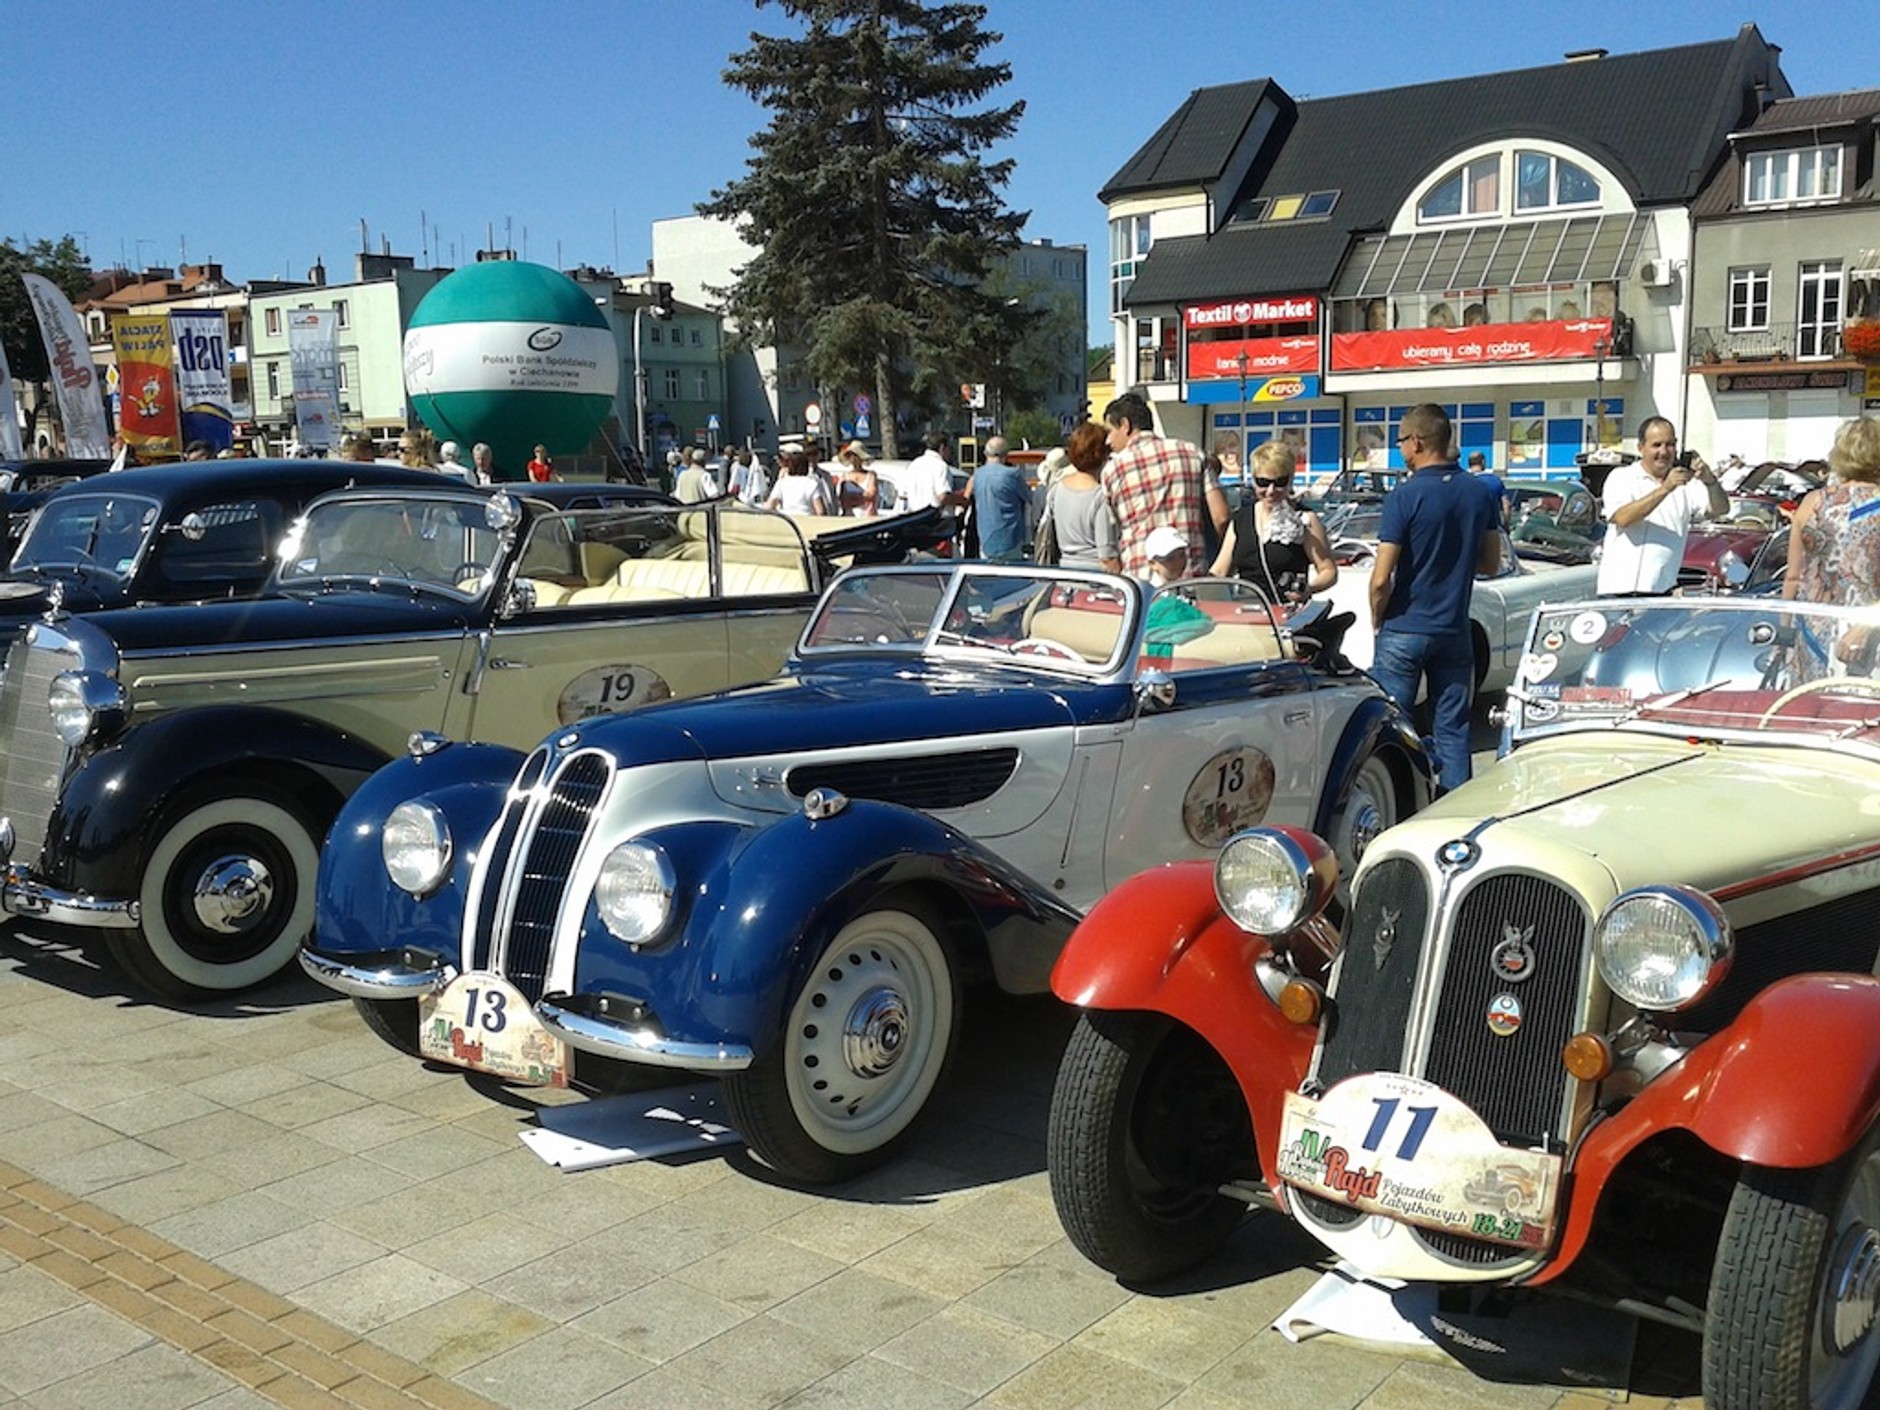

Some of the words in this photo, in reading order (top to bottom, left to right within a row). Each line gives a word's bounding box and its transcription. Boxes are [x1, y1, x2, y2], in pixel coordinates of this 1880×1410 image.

[1188, 306, 1232, 324] Textil
[1252, 301, 1313, 320] Market
[482, 355, 514, 365] Polski
[516, 355, 542, 365] Bank
[1403, 345, 1453, 360] ubieramy
[520, 367, 579, 378] Ciechanowie
[1268, 383, 1301, 395] PEPCO
[1582, 620, 1595, 635] 2
[600, 673, 635, 702] 19
[1216, 757, 1244, 798] 13
[465, 988, 507, 1033] 13
[1361, 1097, 1438, 1161] 11
[1324, 1145, 1383, 1202] Rajd
[1382, 1178, 1446, 1205] Pojazdów
[1380, 1193, 1468, 1225] Zabytkowych
[1471, 1211, 1524, 1241] 18-21
